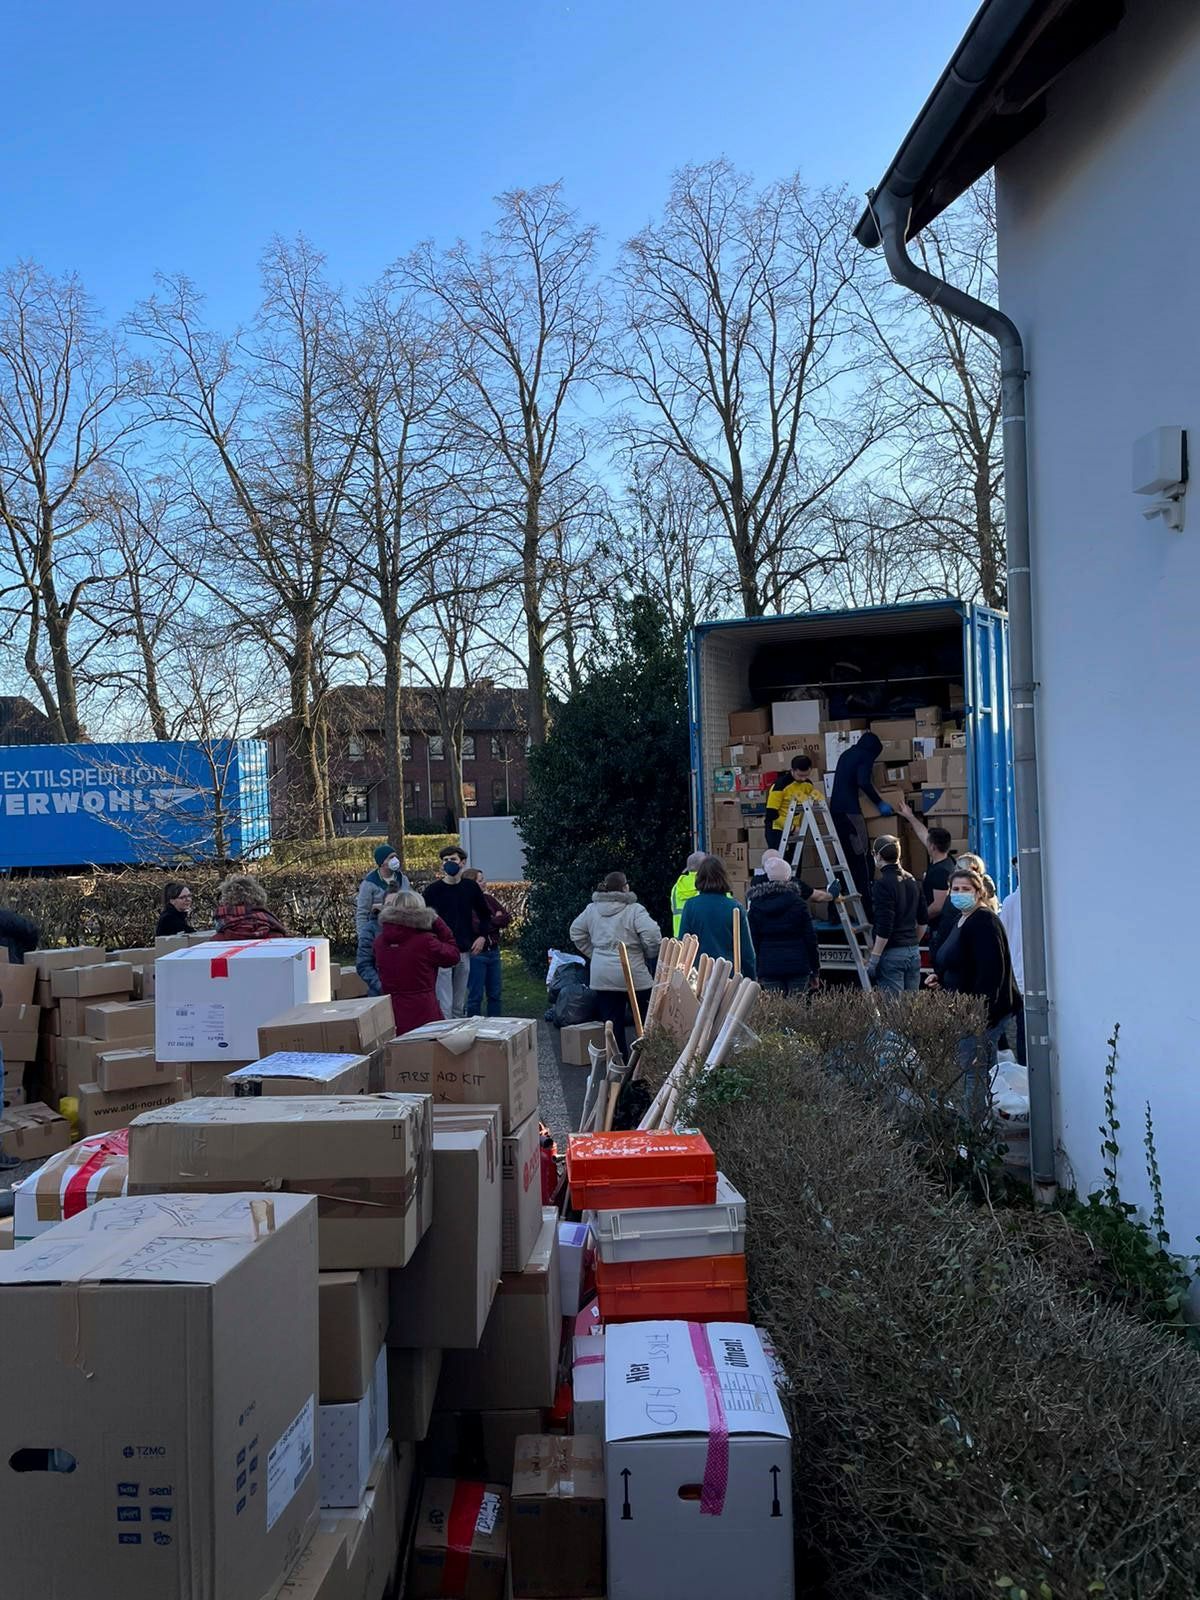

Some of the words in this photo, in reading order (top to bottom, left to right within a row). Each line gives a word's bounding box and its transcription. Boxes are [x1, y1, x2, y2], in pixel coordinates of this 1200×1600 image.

[0, 788, 180, 816] ERWOHLT
[398, 1071, 431, 1083] FIRST
[462, 1072, 487, 1086] KIT
[93, 1096, 176, 1116] www.aldi-nord.de
[645, 1333, 670, 1364] FIRST
[719, 1338, 749, 1369] öffnen!
[626, 1363, 650, 1384] Hier
[640, 1385, 681, 1426] AID
[136, 1446, 166, 1456] TZMO
